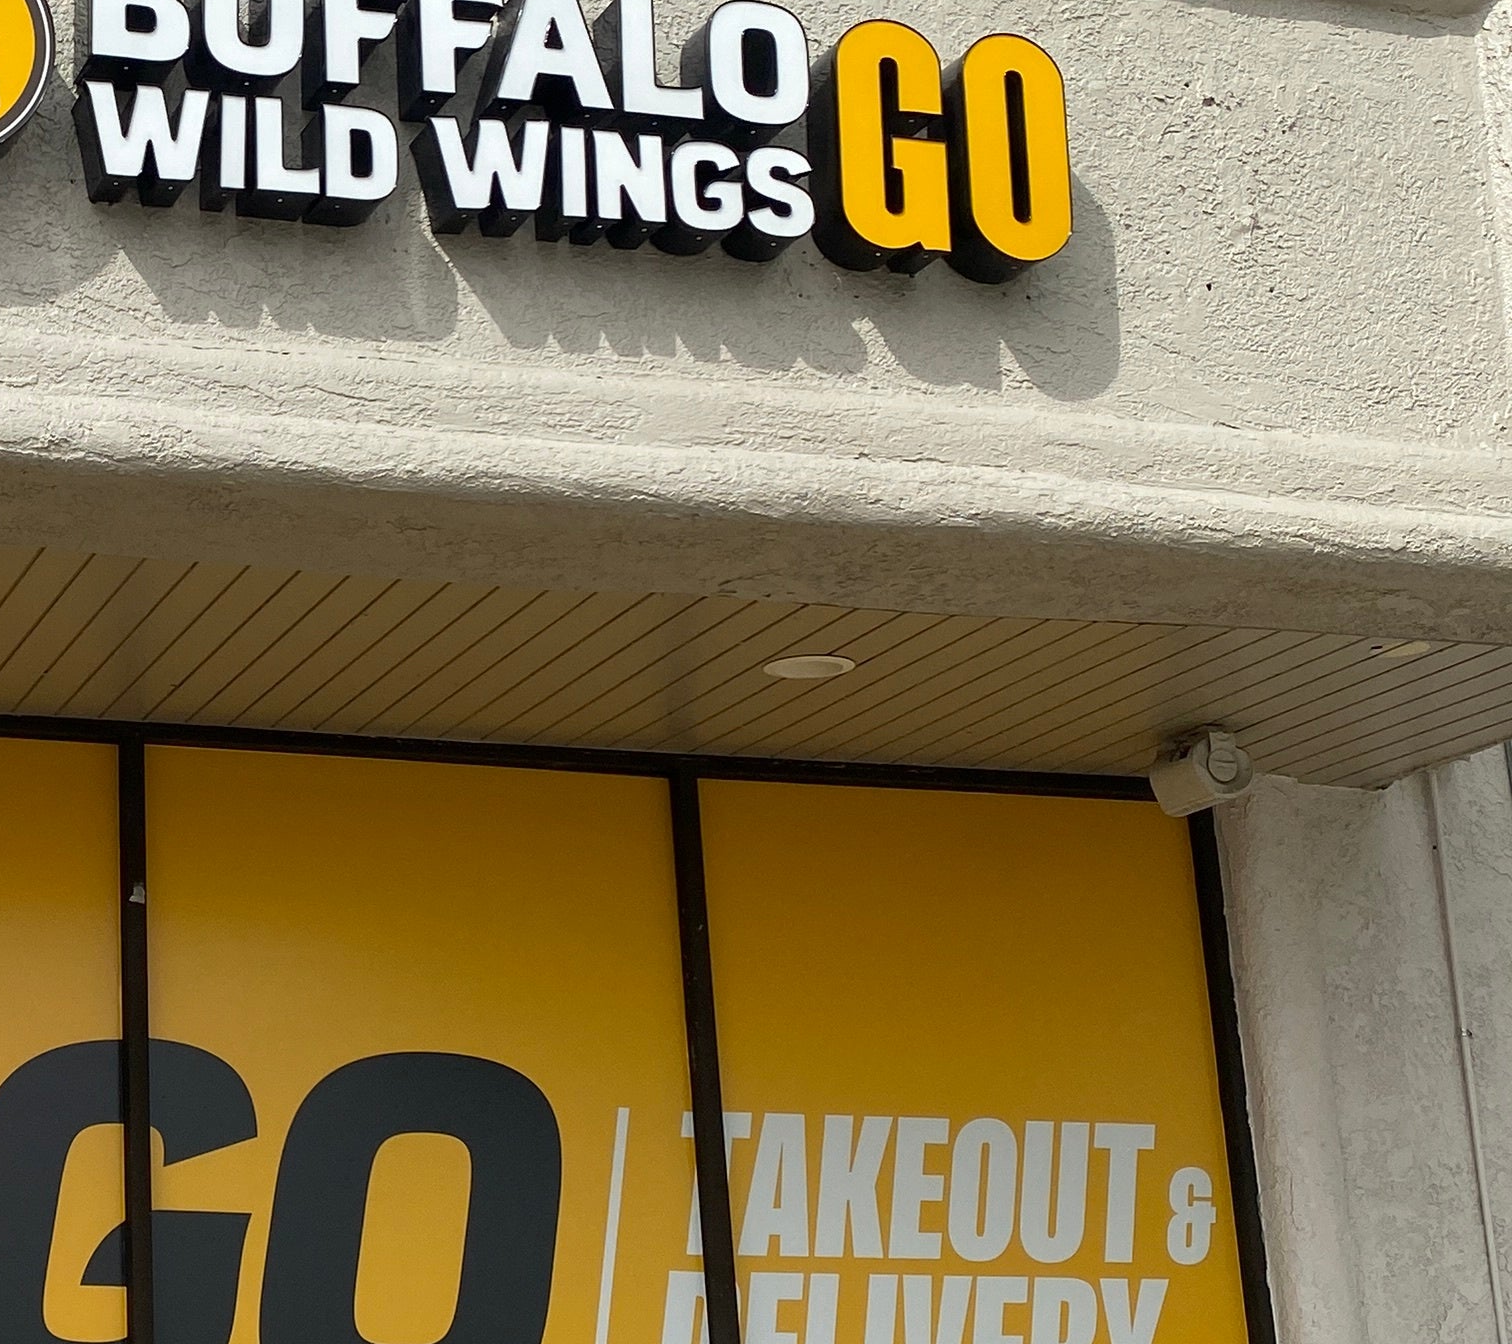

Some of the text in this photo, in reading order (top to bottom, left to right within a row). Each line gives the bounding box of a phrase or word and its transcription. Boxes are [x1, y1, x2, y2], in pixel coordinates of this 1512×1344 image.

[84, 79, 817, 238] WILD WINGS
[835, 18, 1074, 262] GO
[1166, 1166, 1218, 1266] &
